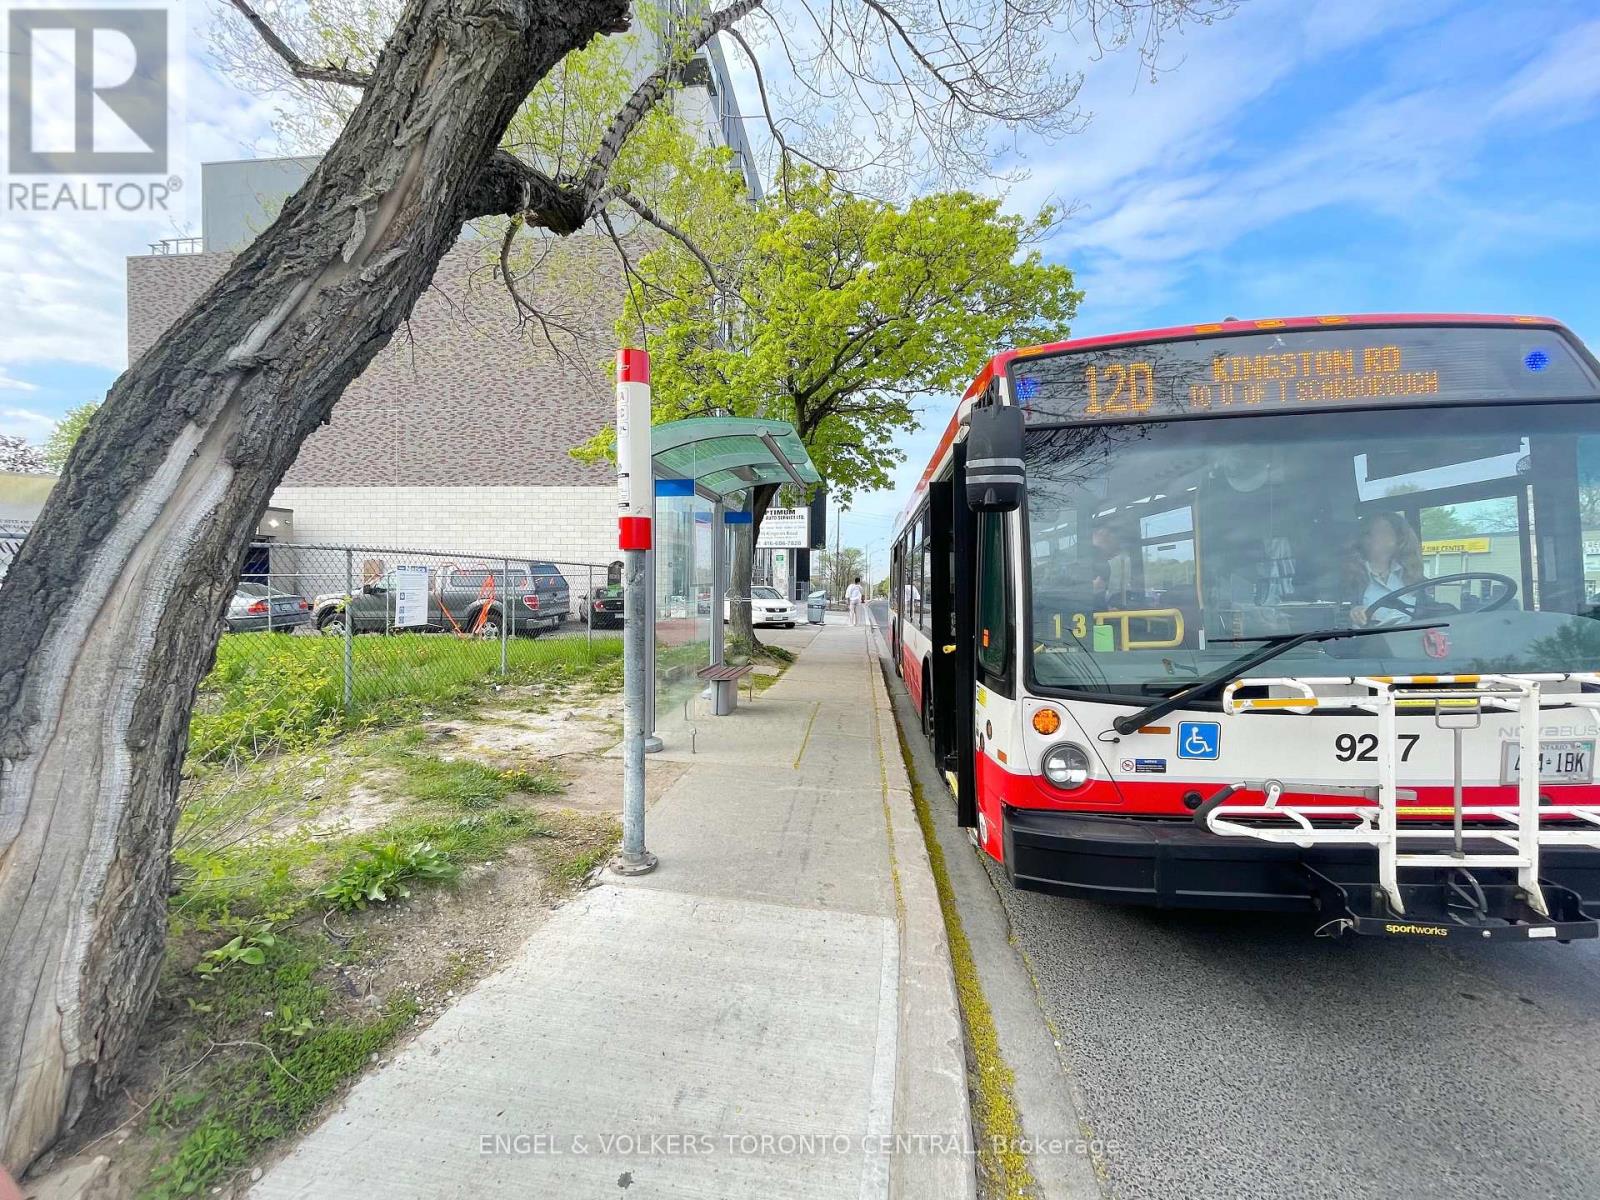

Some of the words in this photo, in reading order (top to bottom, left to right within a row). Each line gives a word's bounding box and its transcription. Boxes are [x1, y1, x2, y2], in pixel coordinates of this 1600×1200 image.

[1212, 349, 1354, 383] KINGSTON
[1363, 344, 1402, 374] RD
[1189, 384, 1212, 407] TO
[1243, 382, 1267, 404] OF
[1279, 380, 1289, 402] T
[1296, 370, 1440, 402] SCARBOROUGH
[1335, 733, 1420, 762] 927
[1385, 924, 1448, 937] sportworks
